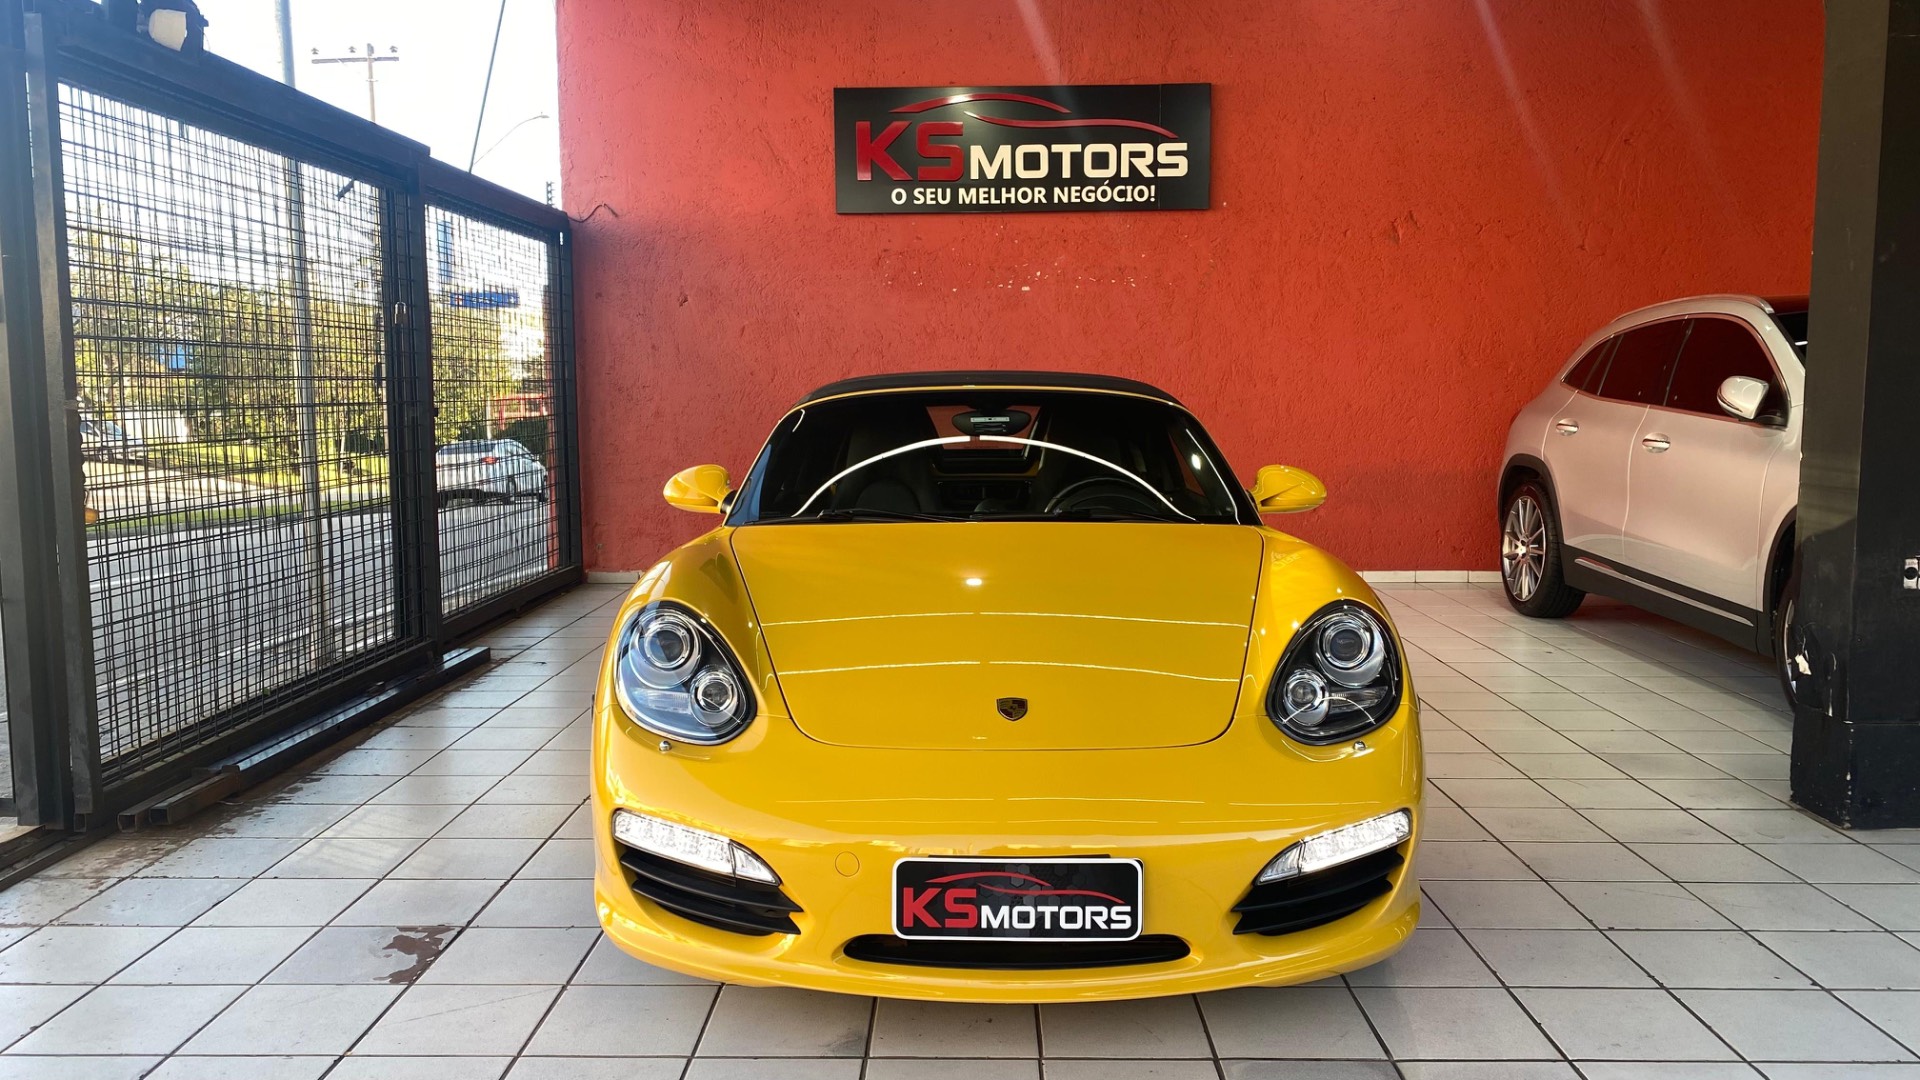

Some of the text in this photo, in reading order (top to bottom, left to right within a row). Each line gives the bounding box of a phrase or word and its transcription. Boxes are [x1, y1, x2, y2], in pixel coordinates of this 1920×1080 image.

[855, 120, 1189, 182] KS MOTORS
[891, 180, 1156, 206] O SEU MELHOR NEGÓCIO!
[902, 887, 1132, 930] KS MOTORS
